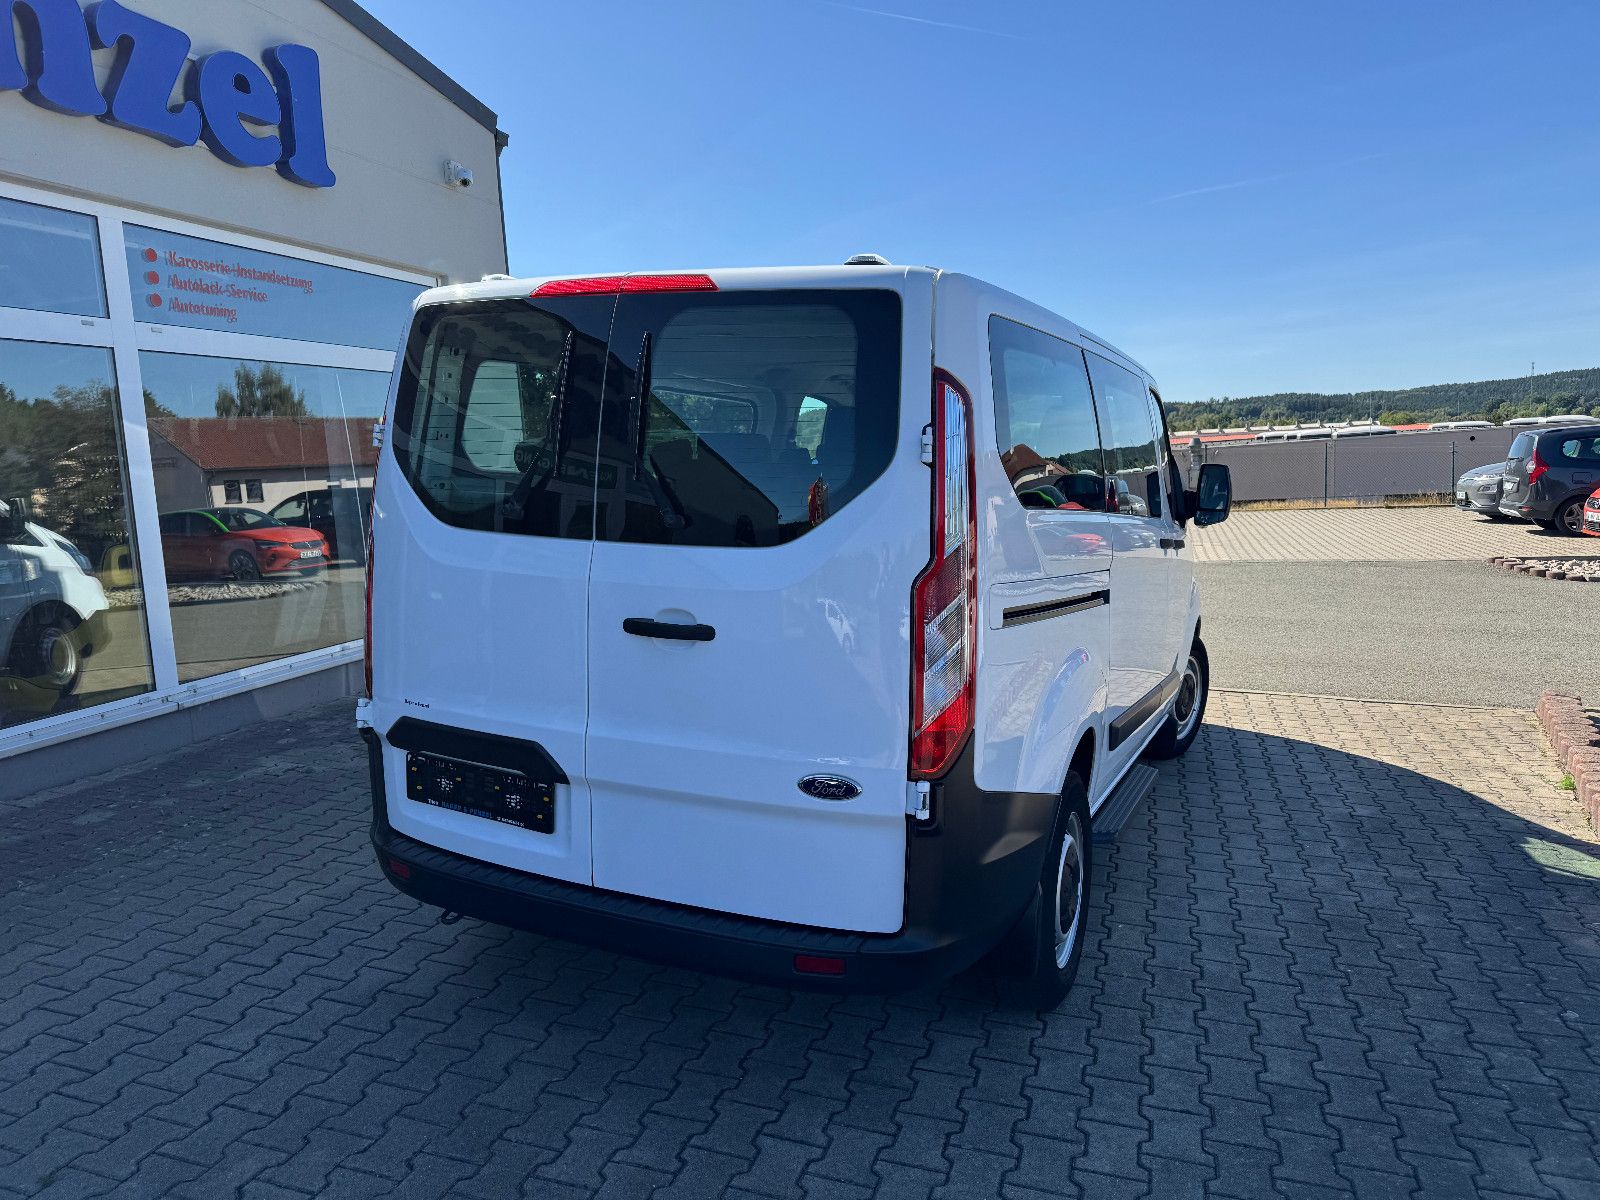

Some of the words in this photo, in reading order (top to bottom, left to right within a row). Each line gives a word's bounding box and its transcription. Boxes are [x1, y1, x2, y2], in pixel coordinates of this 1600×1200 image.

[0, 0, 336, 187] nzel
[166, 251, 313, 293] Karosserie-Instandsetzung
[169, 274, 269, 302] Autolack-Service
[169, 297, 238, 323] Autotuning
[811, 779, 847, 796] Ford
